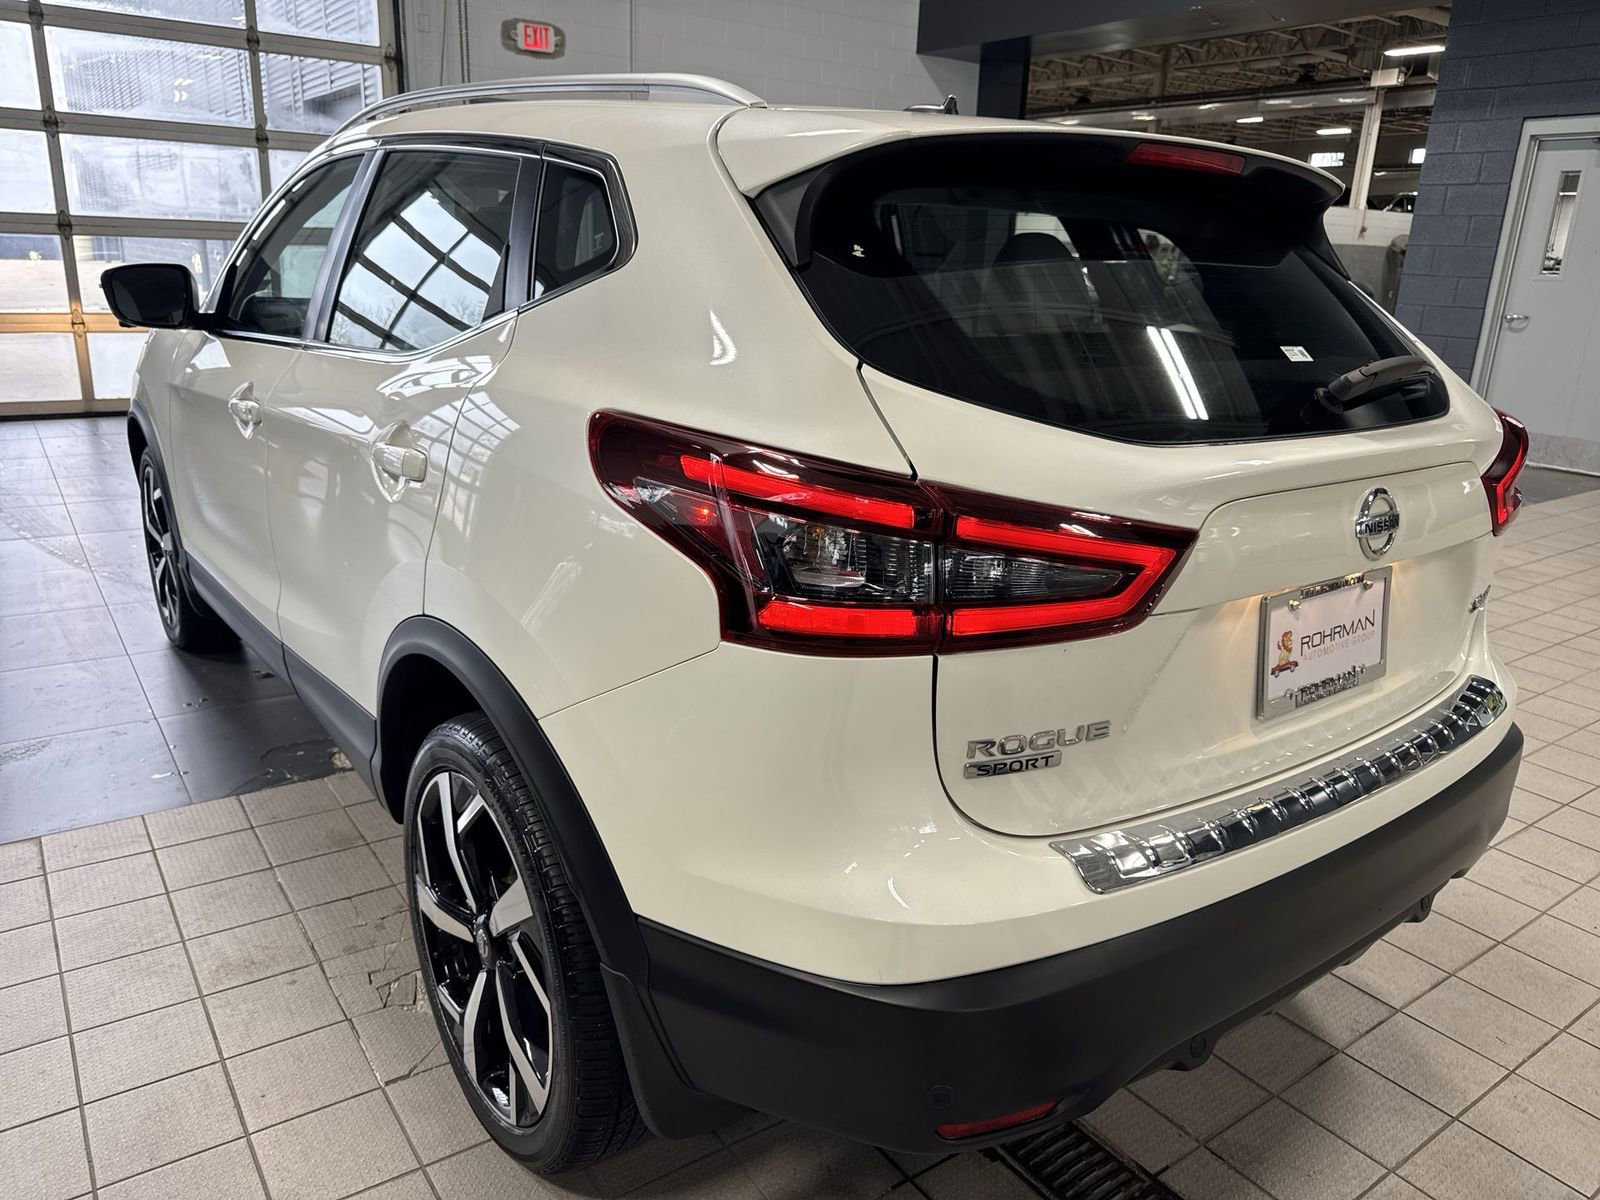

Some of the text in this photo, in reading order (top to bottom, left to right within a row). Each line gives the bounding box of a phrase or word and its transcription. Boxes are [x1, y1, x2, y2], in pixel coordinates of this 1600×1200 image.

[524, 24, 551, 49] EXIT
[1365, 514, 1400, 533] NISSAN
[1300, 609, 1376, 656] ROHRMAN
[1303, 630, 1376, 661] AUTOMOTIVE GROUP
[966, 720, 1112, 760] ROGUE
[976, 755, 1055, 777] SPORT
